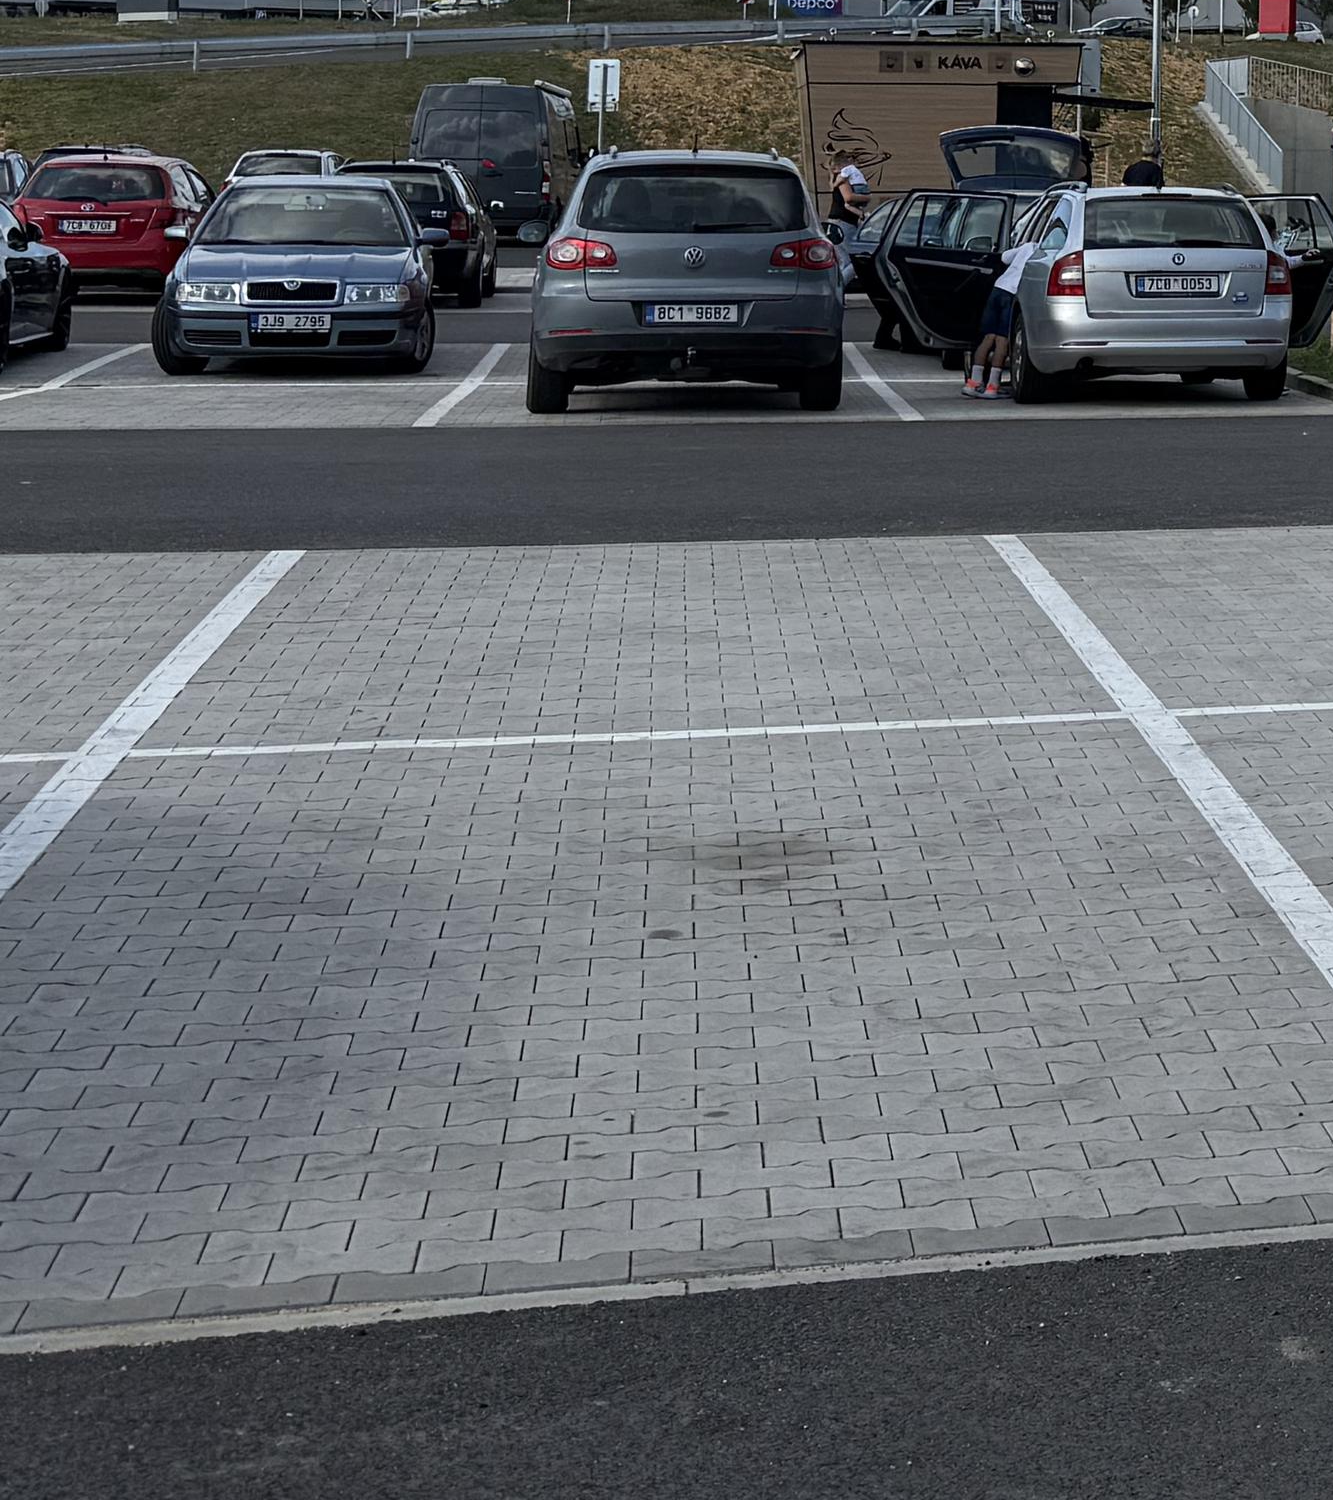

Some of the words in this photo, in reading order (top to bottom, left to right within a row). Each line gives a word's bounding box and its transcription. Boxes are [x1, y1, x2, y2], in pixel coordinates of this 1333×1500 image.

[937, 53, 983, 70] KÁVA
[1181, 278, 1212, 290] 0053
[657, 306, 683, 320] 8C1
[261, 315, 285, 327] 3J9
[294, 315, 326, 327] 2795
